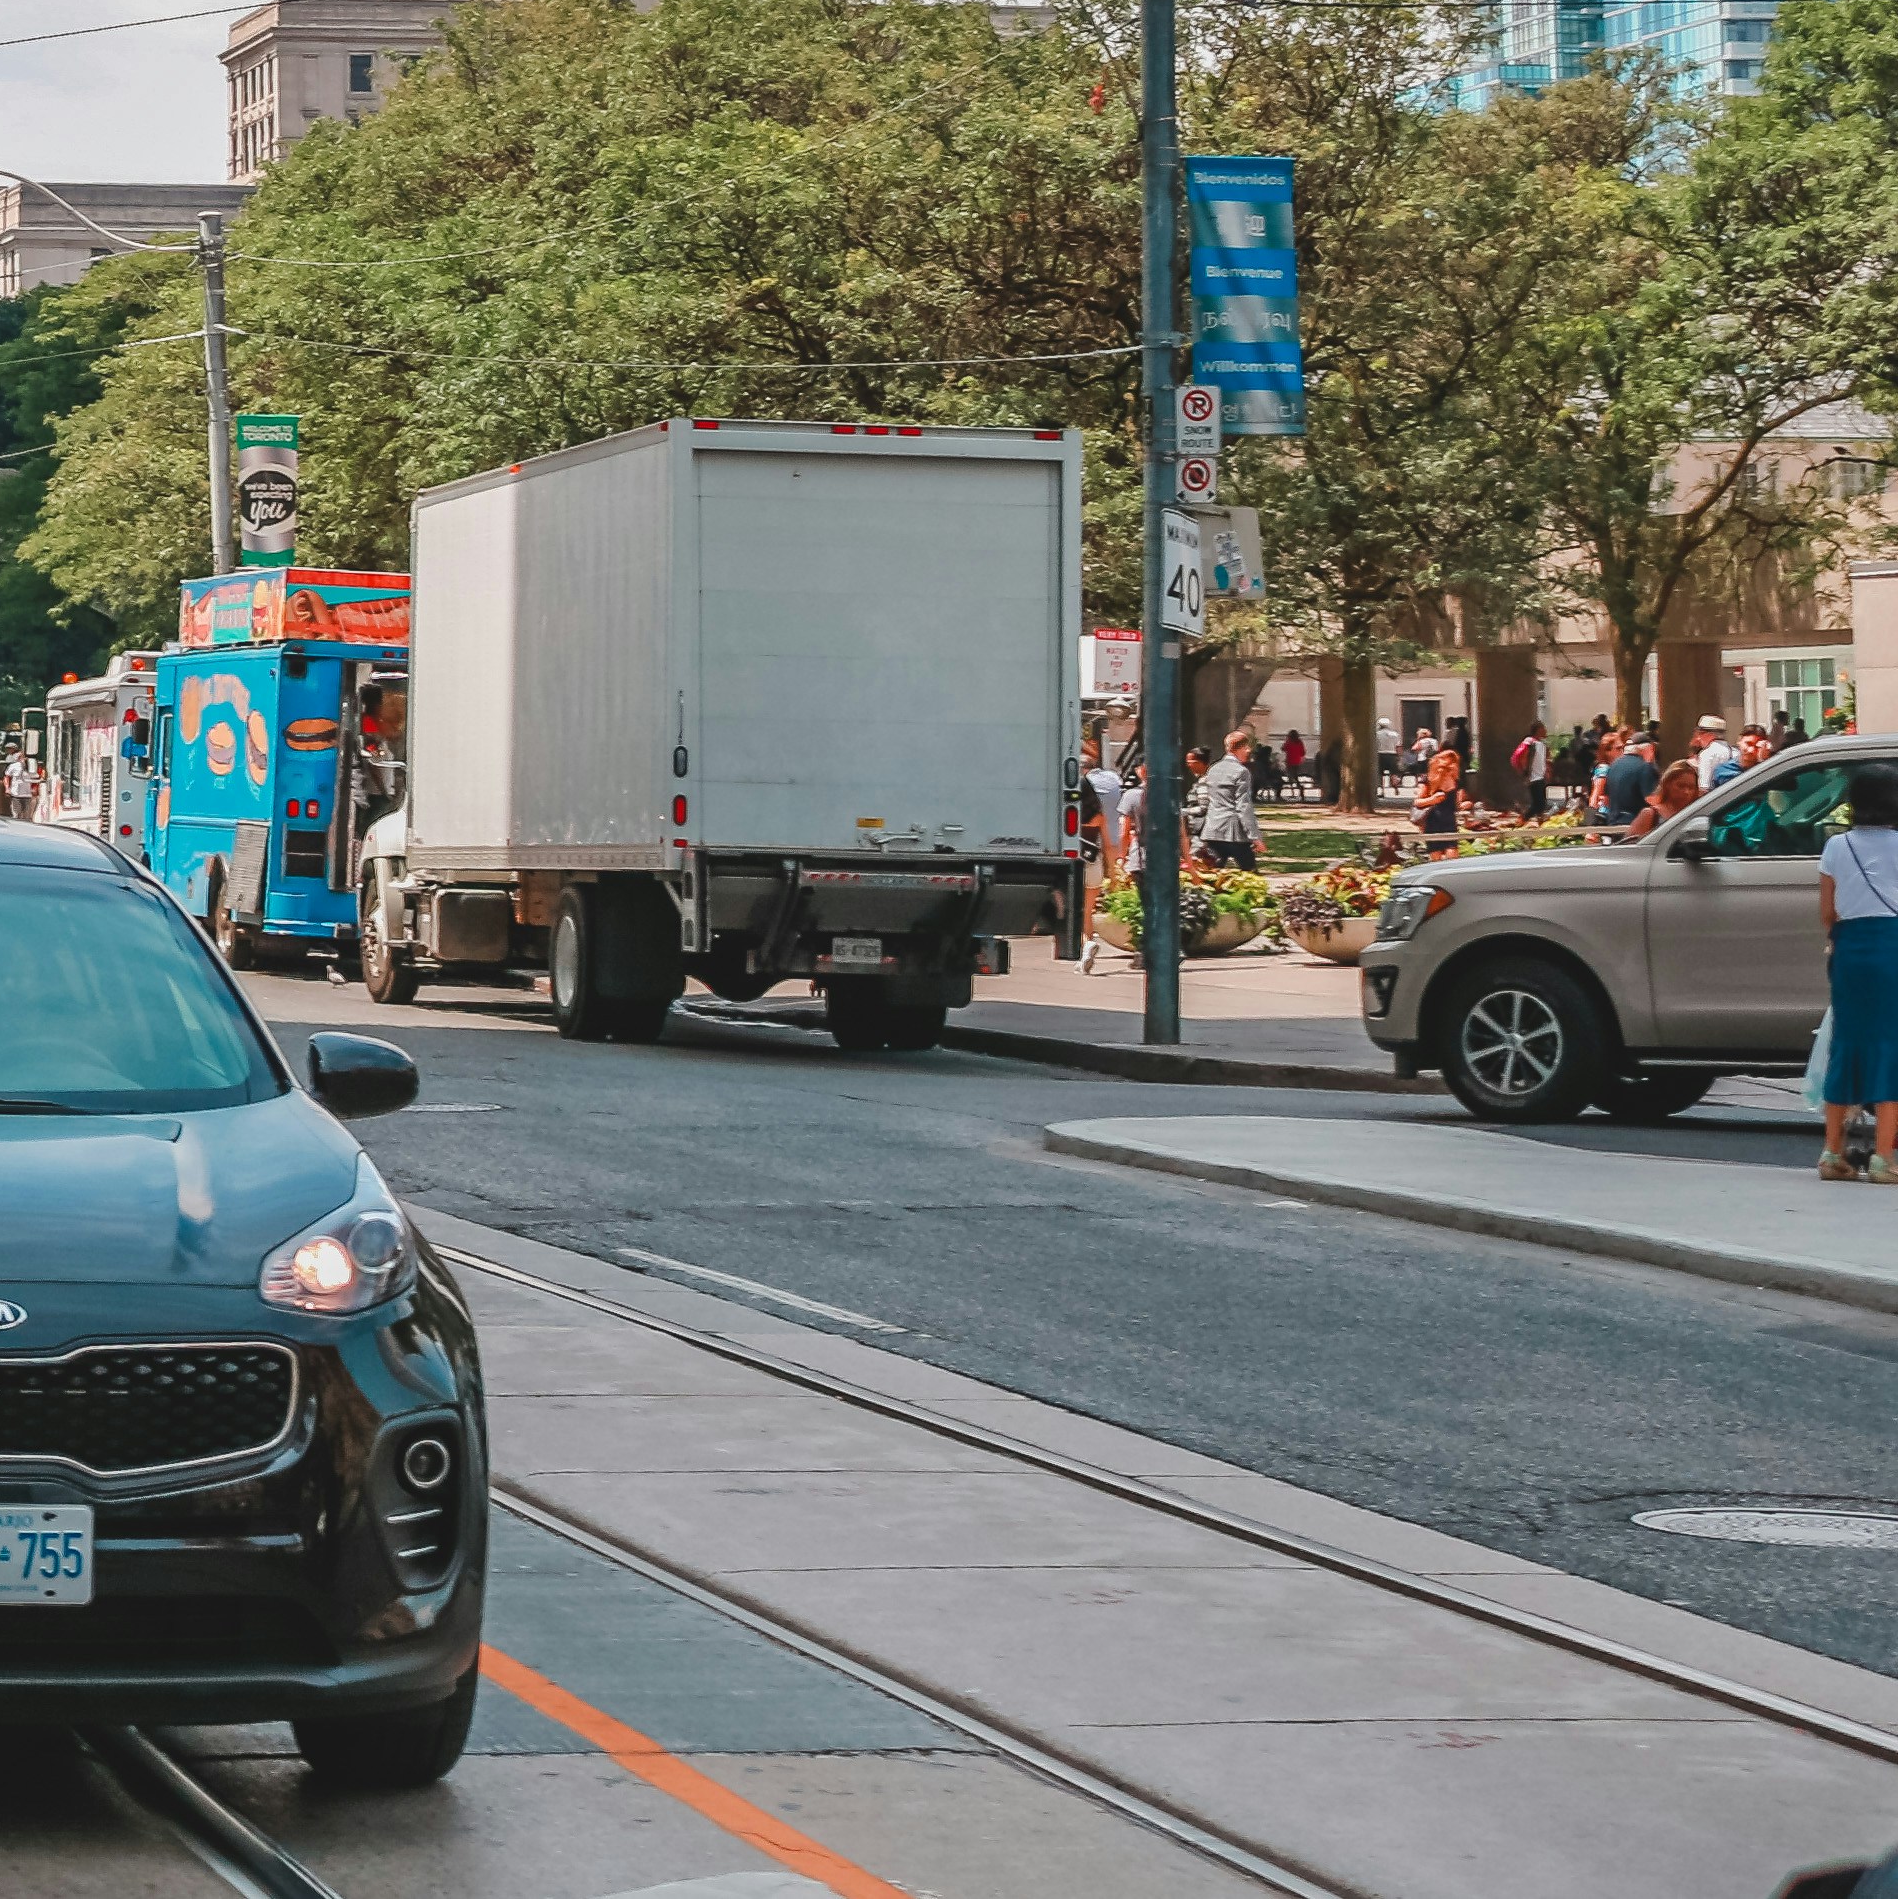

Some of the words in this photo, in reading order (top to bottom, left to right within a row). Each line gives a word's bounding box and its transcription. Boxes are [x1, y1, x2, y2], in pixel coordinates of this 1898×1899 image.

[243, 432, 294, 442] TORONTO
[1181, 438, 1214, 448] ROUTE
[250, 500, 287, 531] you
[1166, 564, 1200, 618] 40
[17, 1531, 84, 1579] 755
